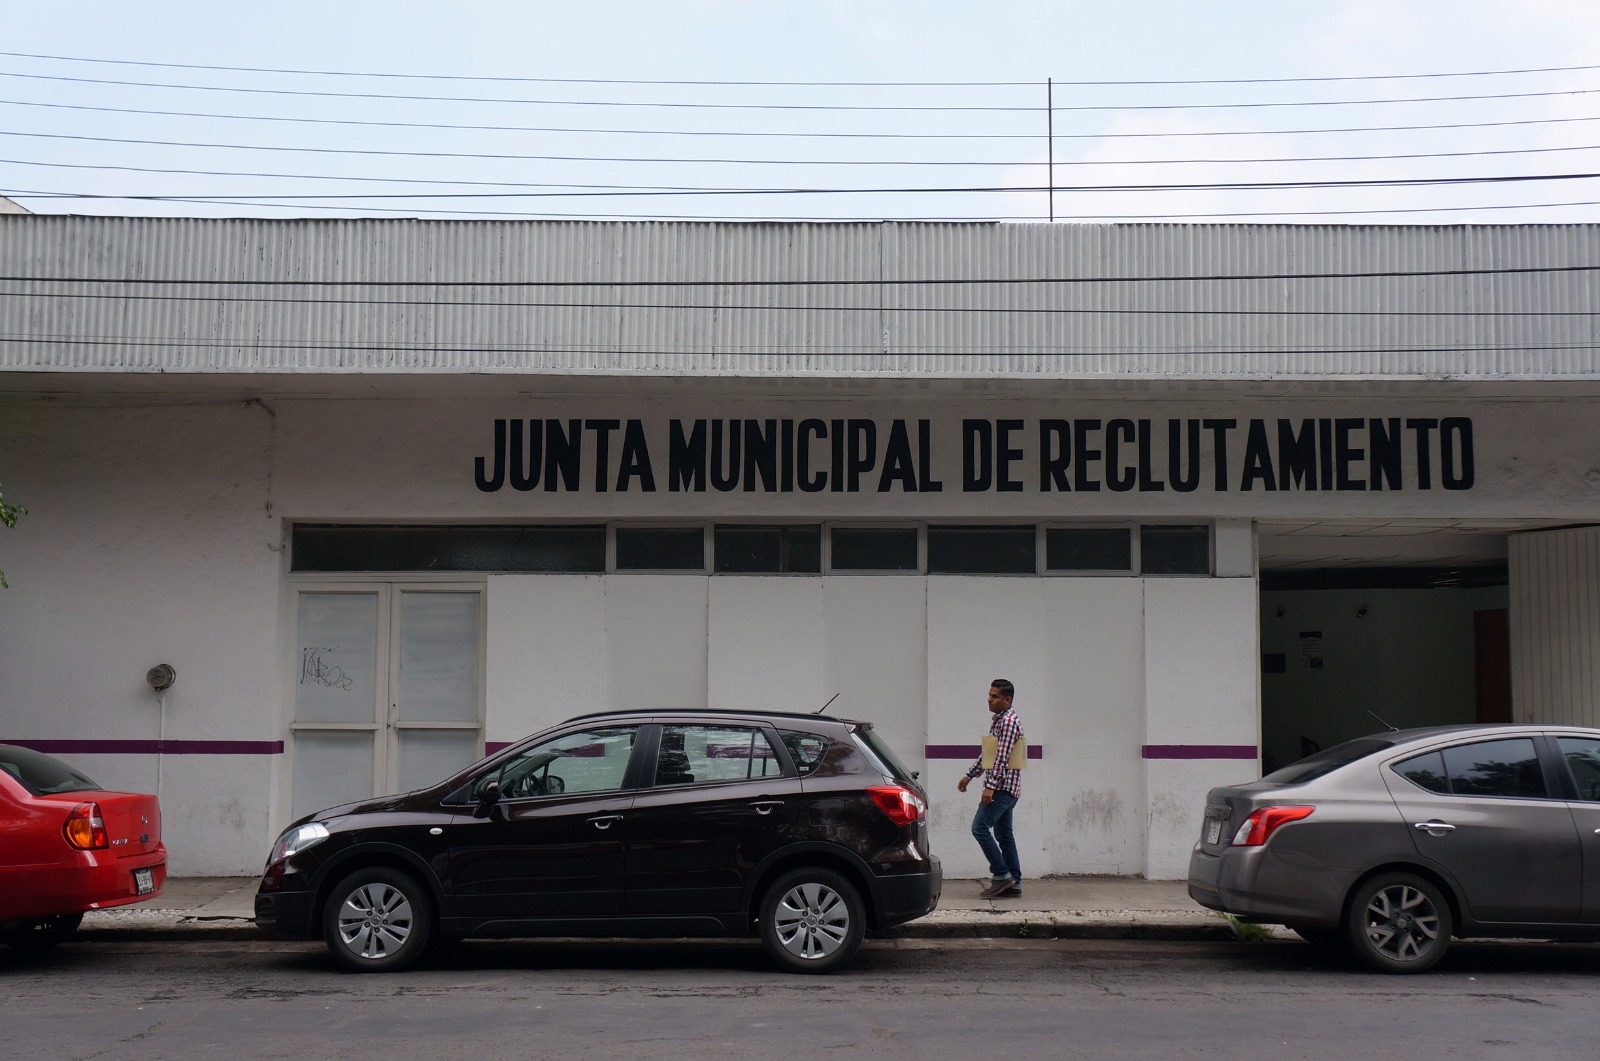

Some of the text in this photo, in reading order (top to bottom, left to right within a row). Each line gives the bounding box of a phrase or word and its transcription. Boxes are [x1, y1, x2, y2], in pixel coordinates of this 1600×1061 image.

[474, 416, 1475, 493] JUNTA MUNICIPAL DE RECLUTAMIENTO
